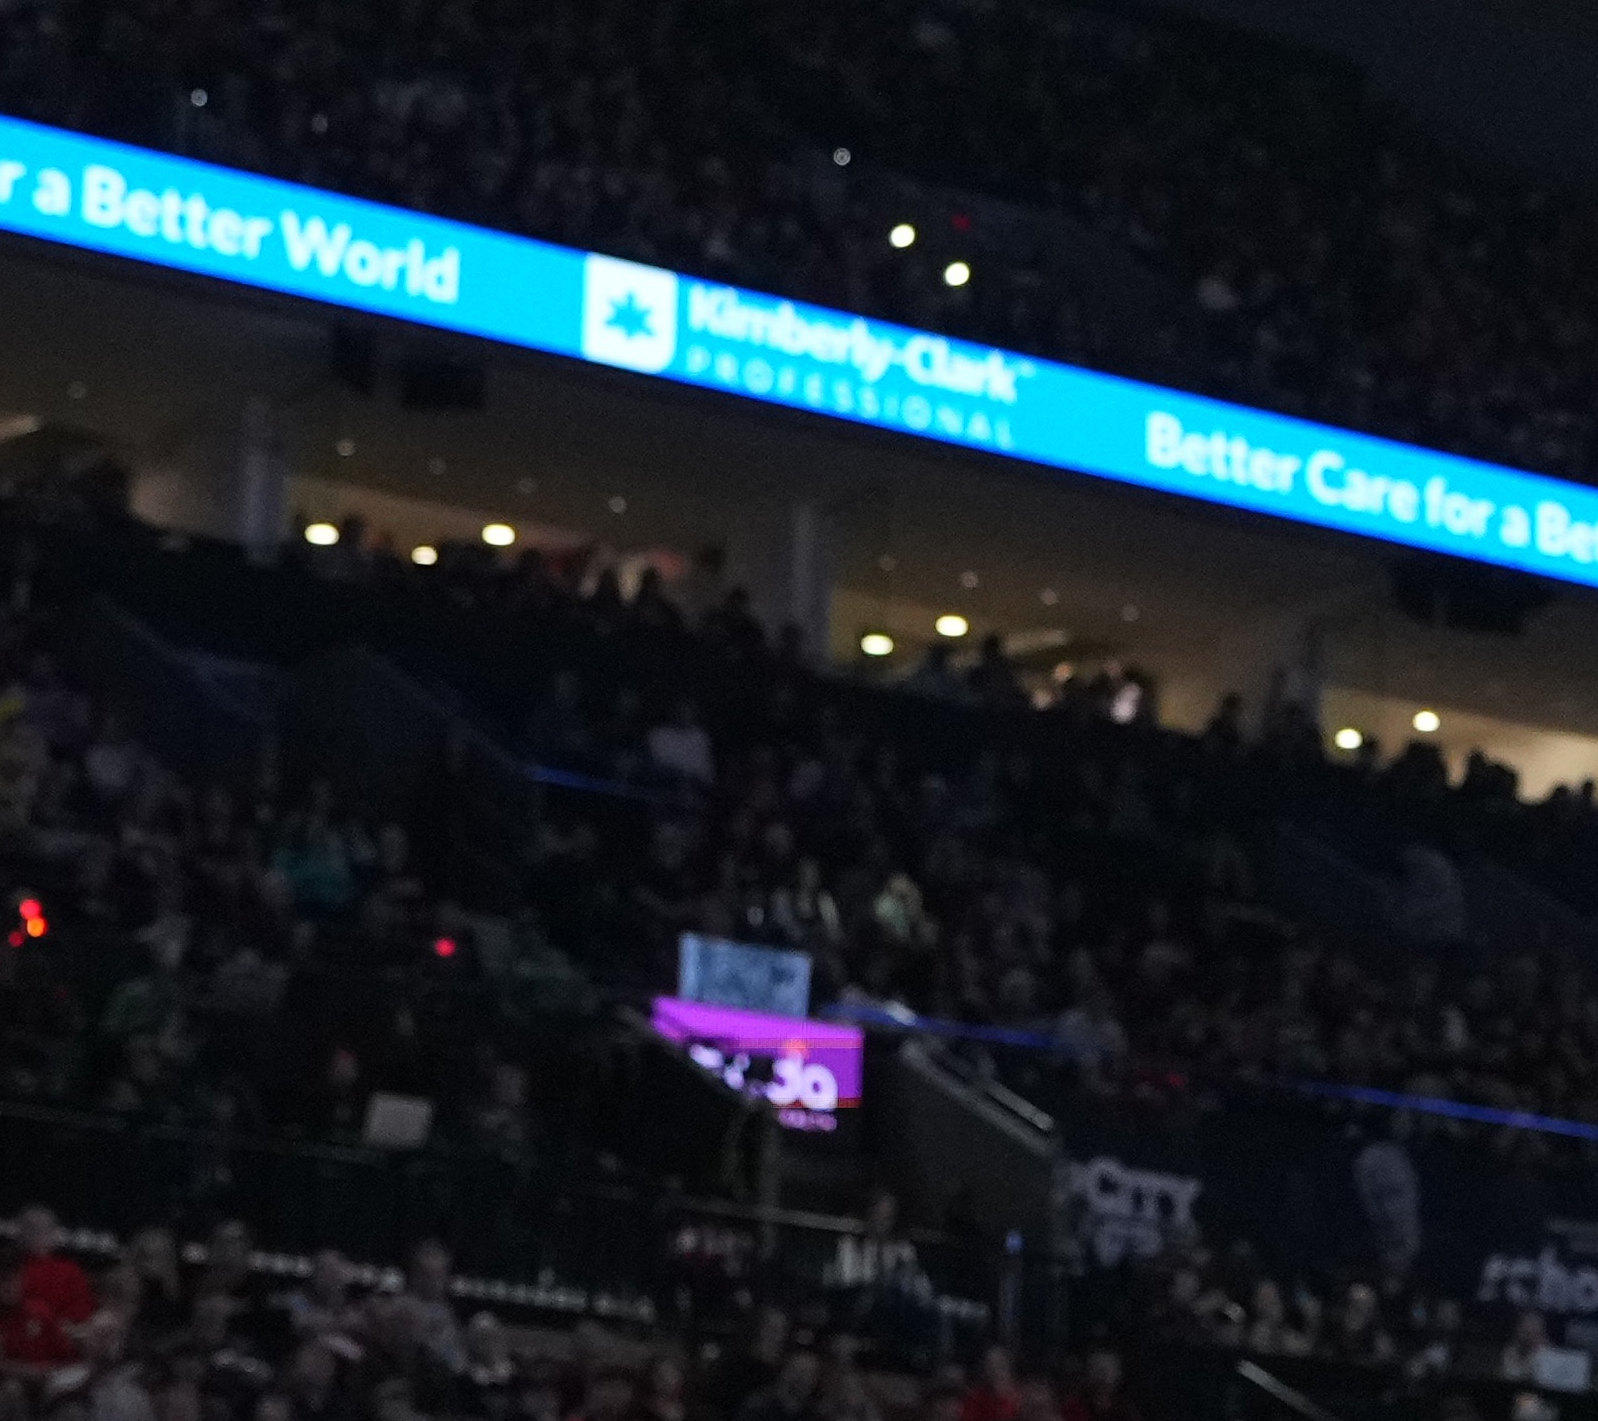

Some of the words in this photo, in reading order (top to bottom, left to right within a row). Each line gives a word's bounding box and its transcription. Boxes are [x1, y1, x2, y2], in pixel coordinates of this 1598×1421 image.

[35, 170, 70, 213] a
[83, 166, 270, 255] Better
[283, 212, 459, 301] World
[688, 282, 1018, 405] Kimberly-Clark
[1148, 412, 1299, 489] Better
[1308, 451, 1418, 521] Care
[1426, 478, 1492, 533] for
[1502, 507, 1529, 545] a
